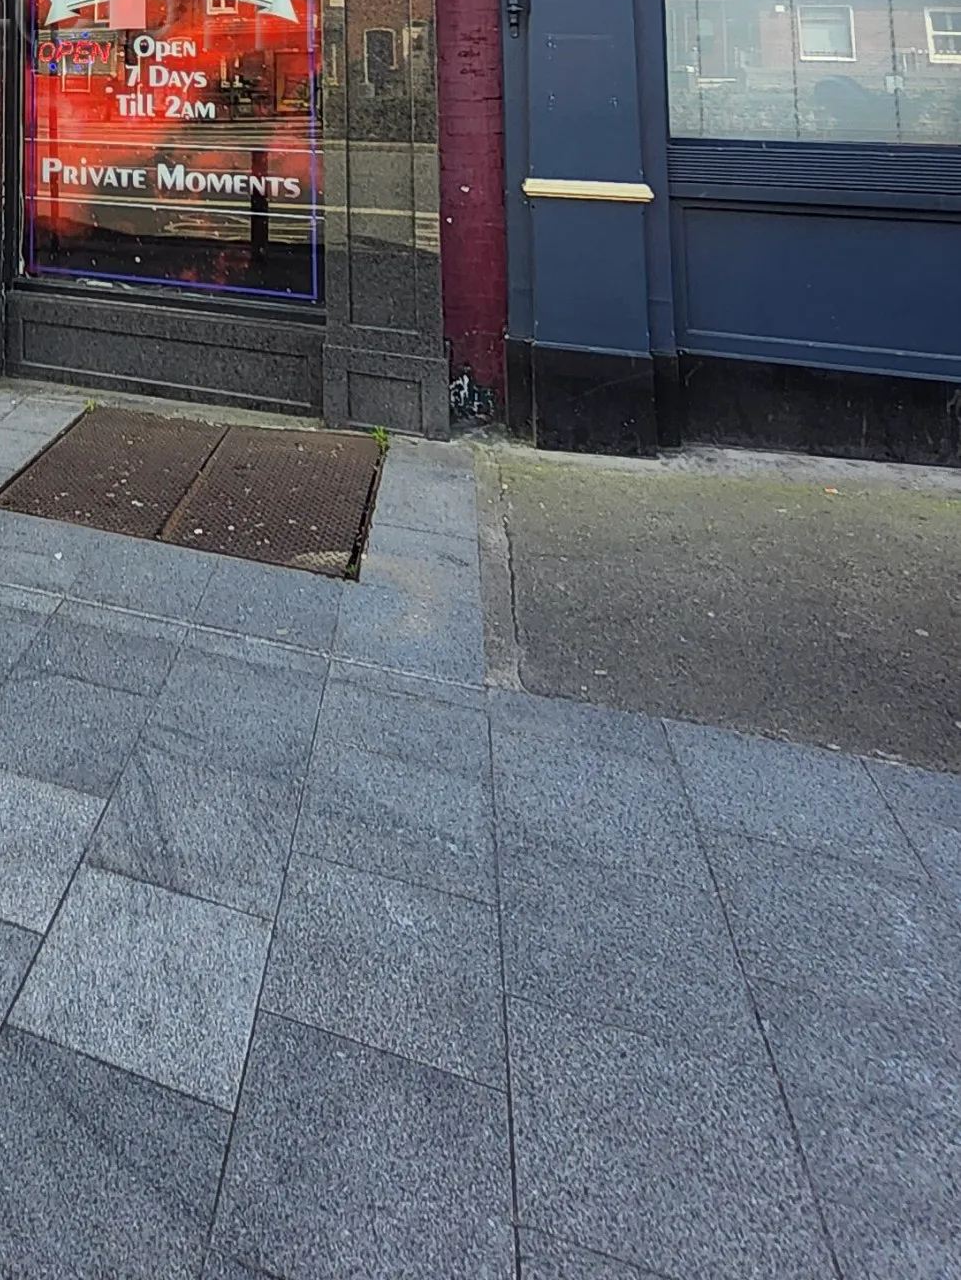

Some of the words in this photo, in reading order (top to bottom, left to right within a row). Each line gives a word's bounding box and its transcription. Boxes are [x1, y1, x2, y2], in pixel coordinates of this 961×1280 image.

[38, 40, 113, 65] OPEN
[125, 64, 140, 88] 7
[116, 94, 155, 118] Till
